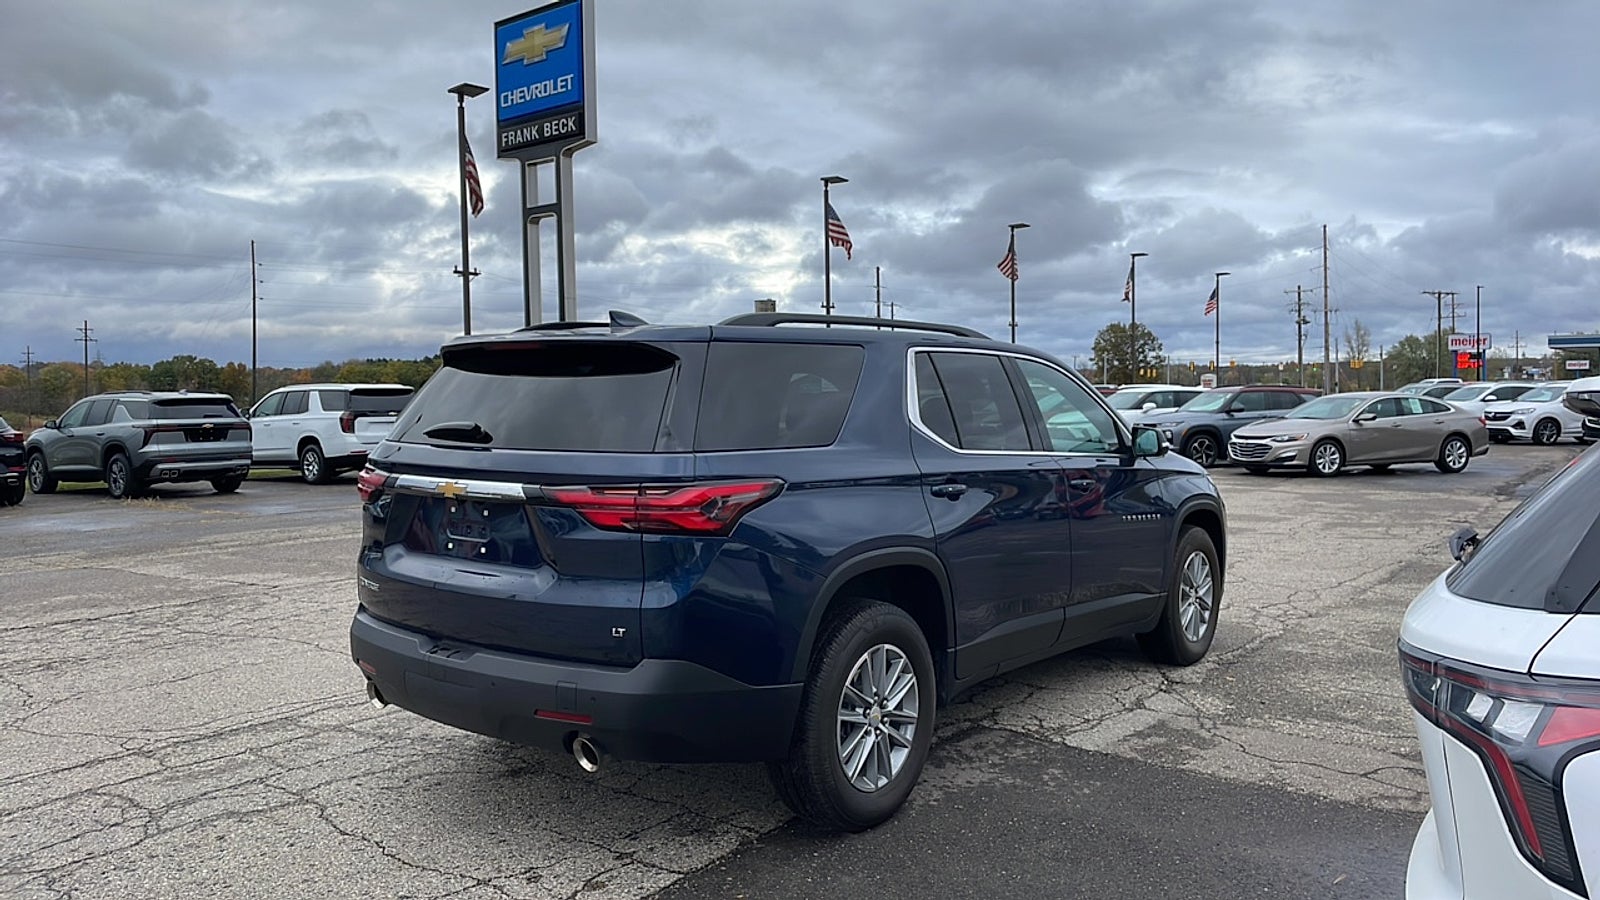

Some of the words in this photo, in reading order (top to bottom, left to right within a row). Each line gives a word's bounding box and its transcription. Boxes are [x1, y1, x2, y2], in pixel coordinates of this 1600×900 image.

[500, 73, 574, 108] CHEVROLET
[501, 125, 539, 147] FRANK
[543, 116, 576, 137] BECK
[612, 627, 626, 637] LT
